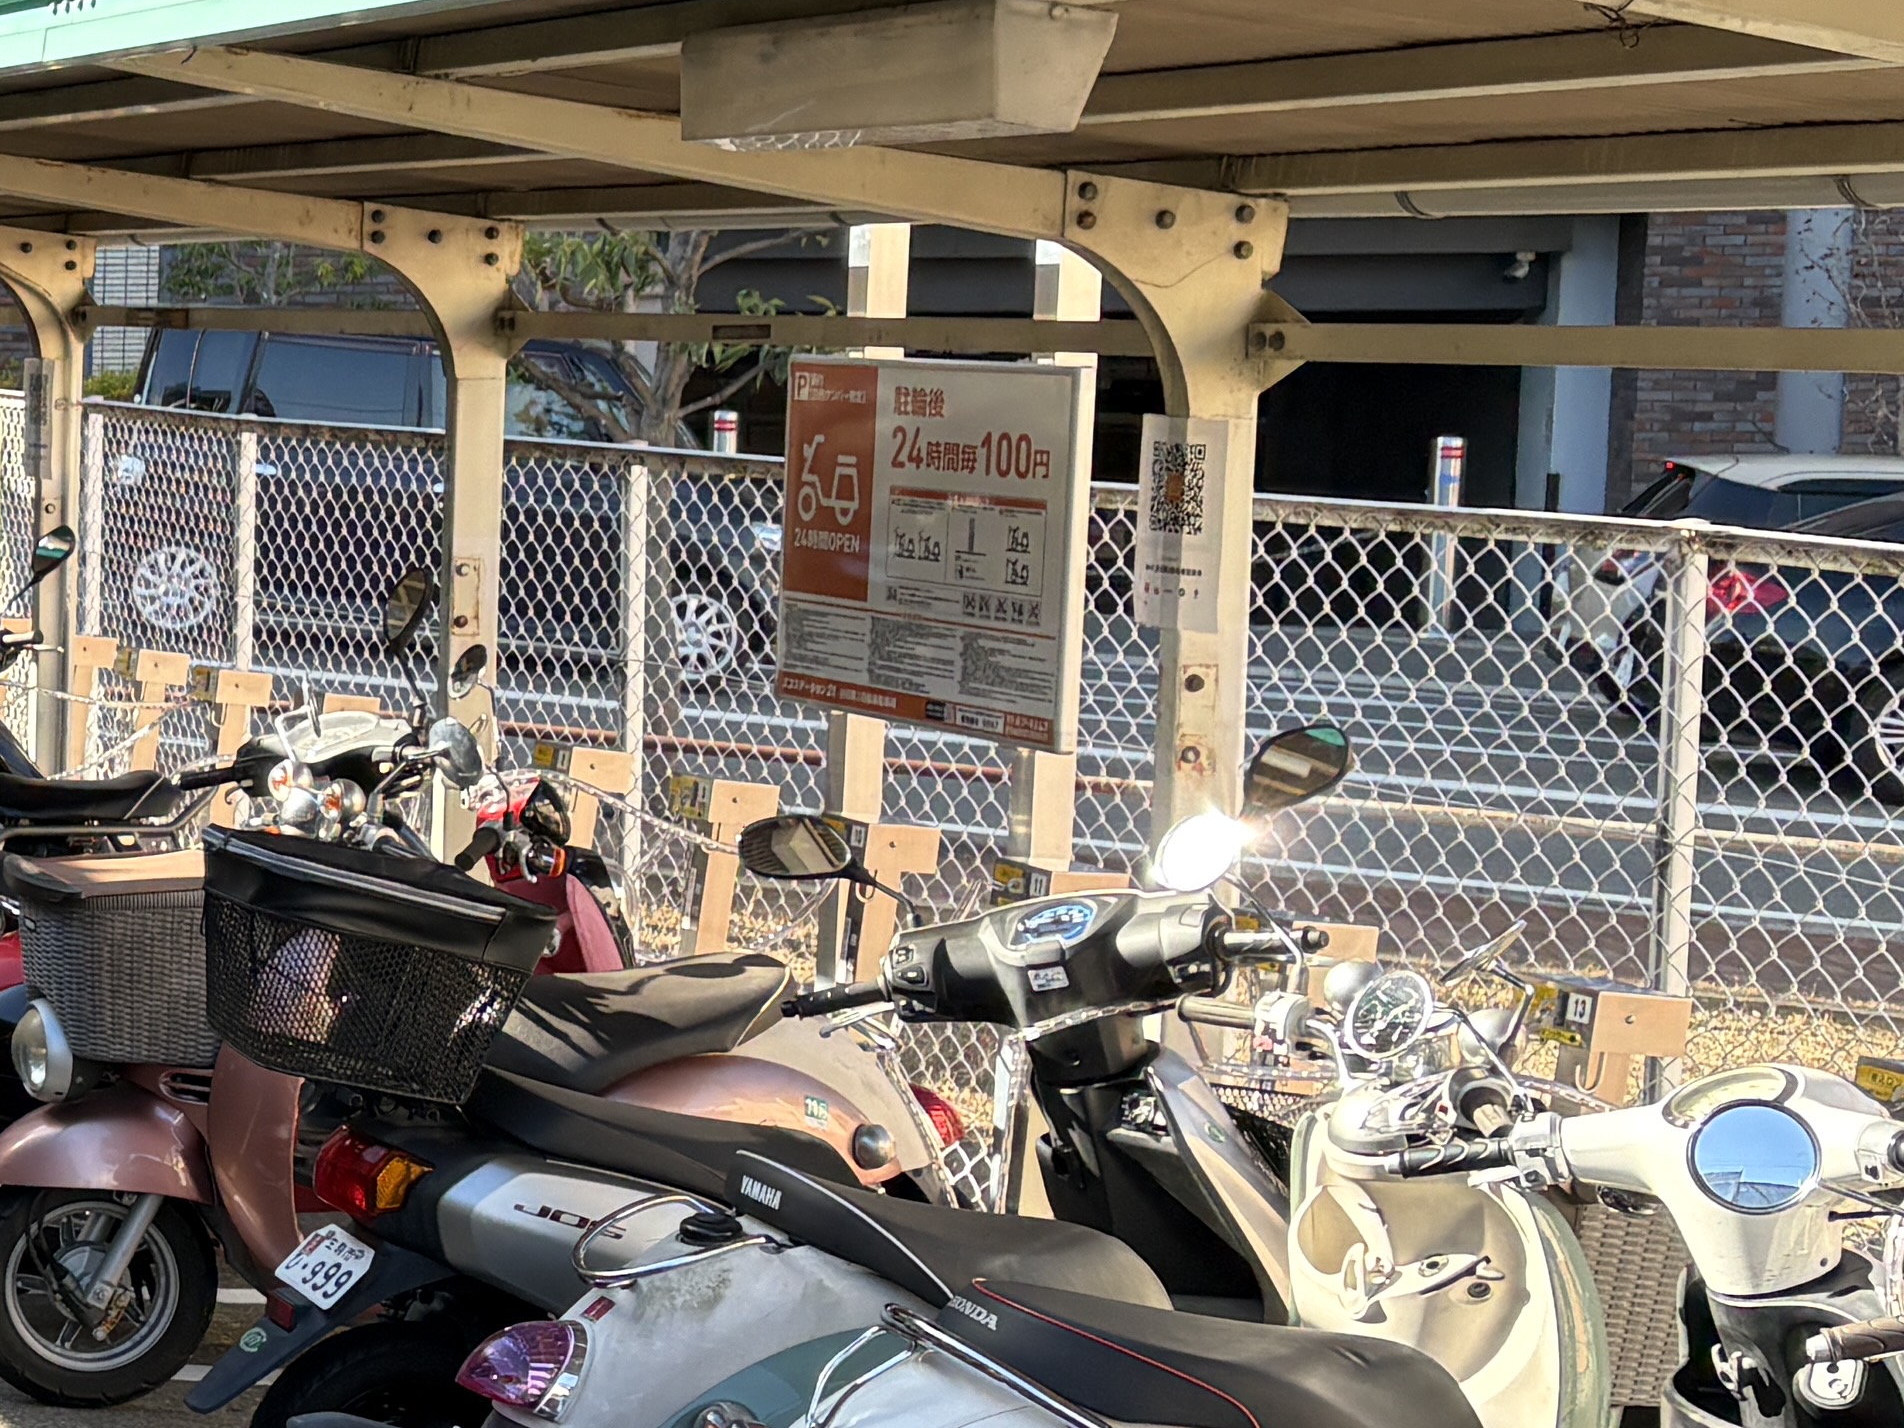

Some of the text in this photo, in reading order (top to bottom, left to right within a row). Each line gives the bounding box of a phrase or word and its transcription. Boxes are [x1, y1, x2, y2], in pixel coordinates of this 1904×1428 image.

[894, 386, 945, 418] 駐輪後
[891, 425, 1051, 479] 24時間毎100円
[740, 1174, 782, 1211] YAMAHA
